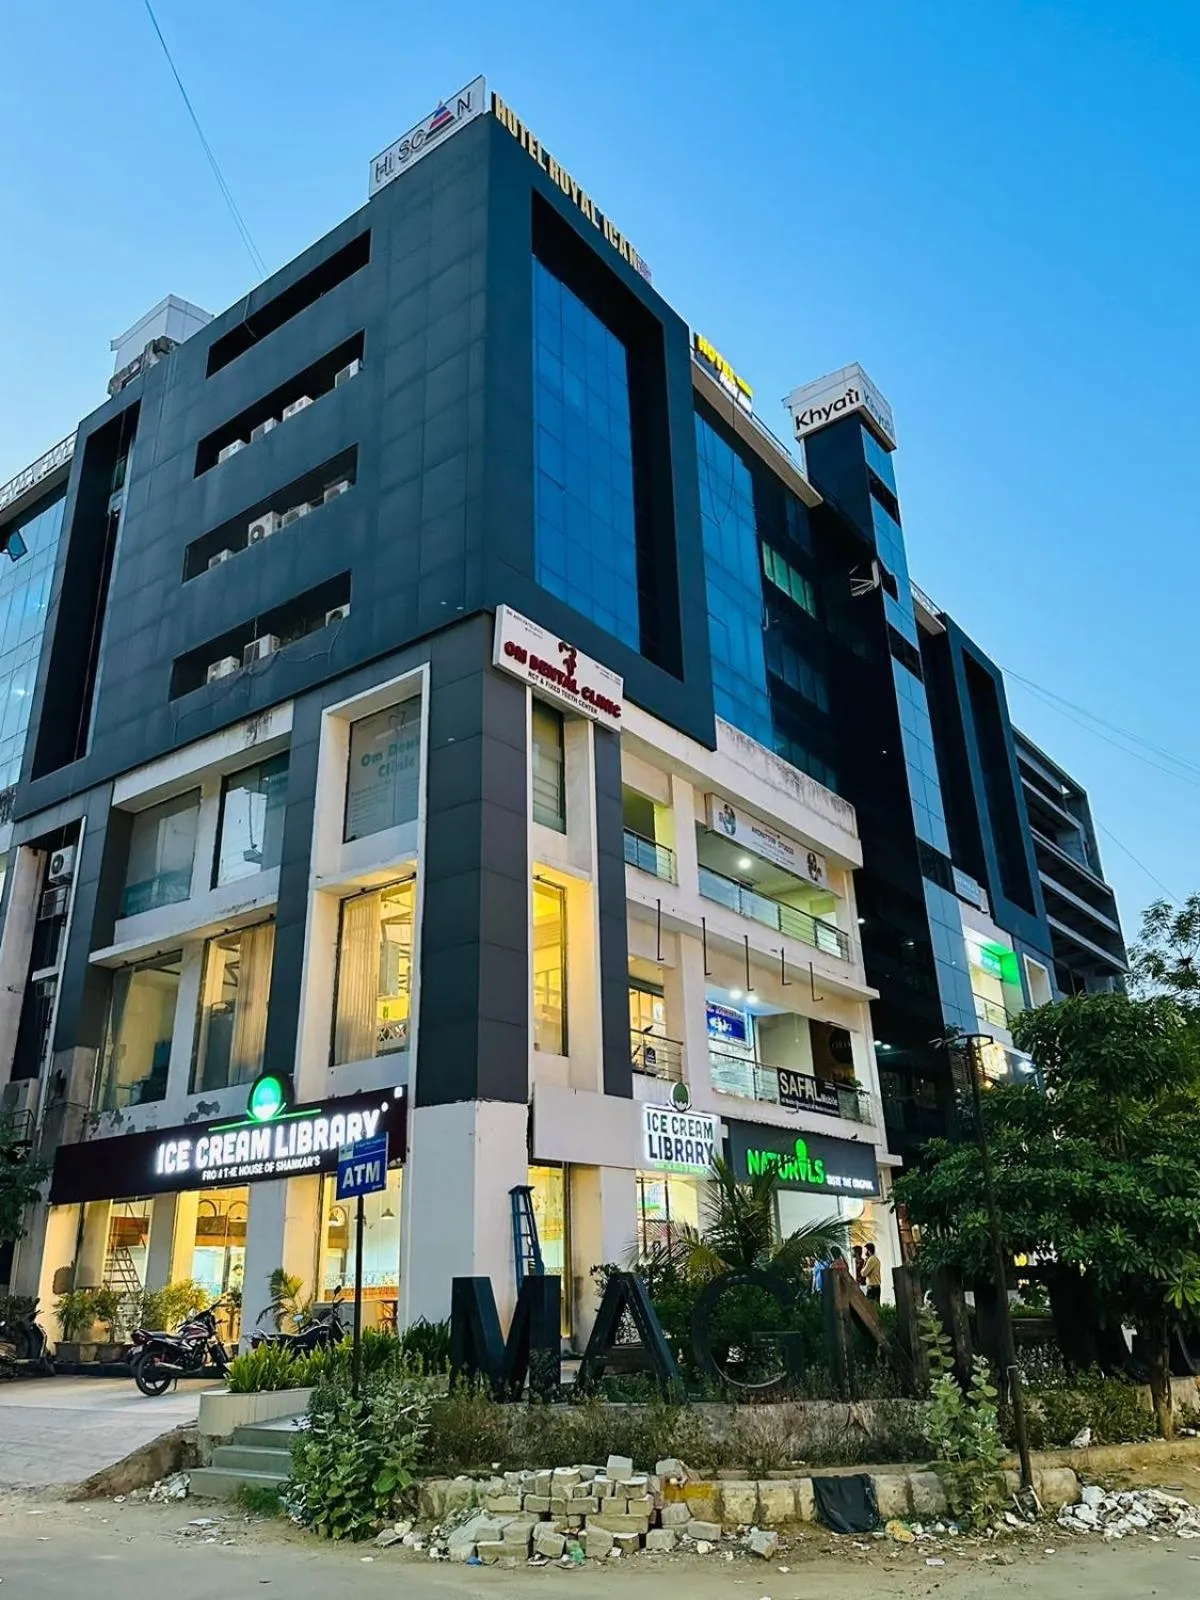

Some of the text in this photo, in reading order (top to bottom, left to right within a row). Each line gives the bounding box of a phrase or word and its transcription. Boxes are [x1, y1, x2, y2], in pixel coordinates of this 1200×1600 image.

[374, 153, 393, 183] Hi
[492, 92, 547, 172] HOTEL
[548, 153, 600, 230] ROYAL
[528, 654, 580, 695] DENTAL
[580, 686, 622, 719] CLINIC
[561, 690, 577, 704] TEETH
[577, 698, 598, 714] CENTER
[779, 1071, 821, 1103] SAFAL
[156, 1108, 380, 1174] ICE CREAM LIBRARY
[646, 1111, 714, 1140] ICE CREAM
[648, 1133, 714, 1166] LIBRARY
[238, 1163, 264, 1176] HOUSE
[264, 1161, 275, 1173] OF
[342, 1160, 381, 1189] ATM
